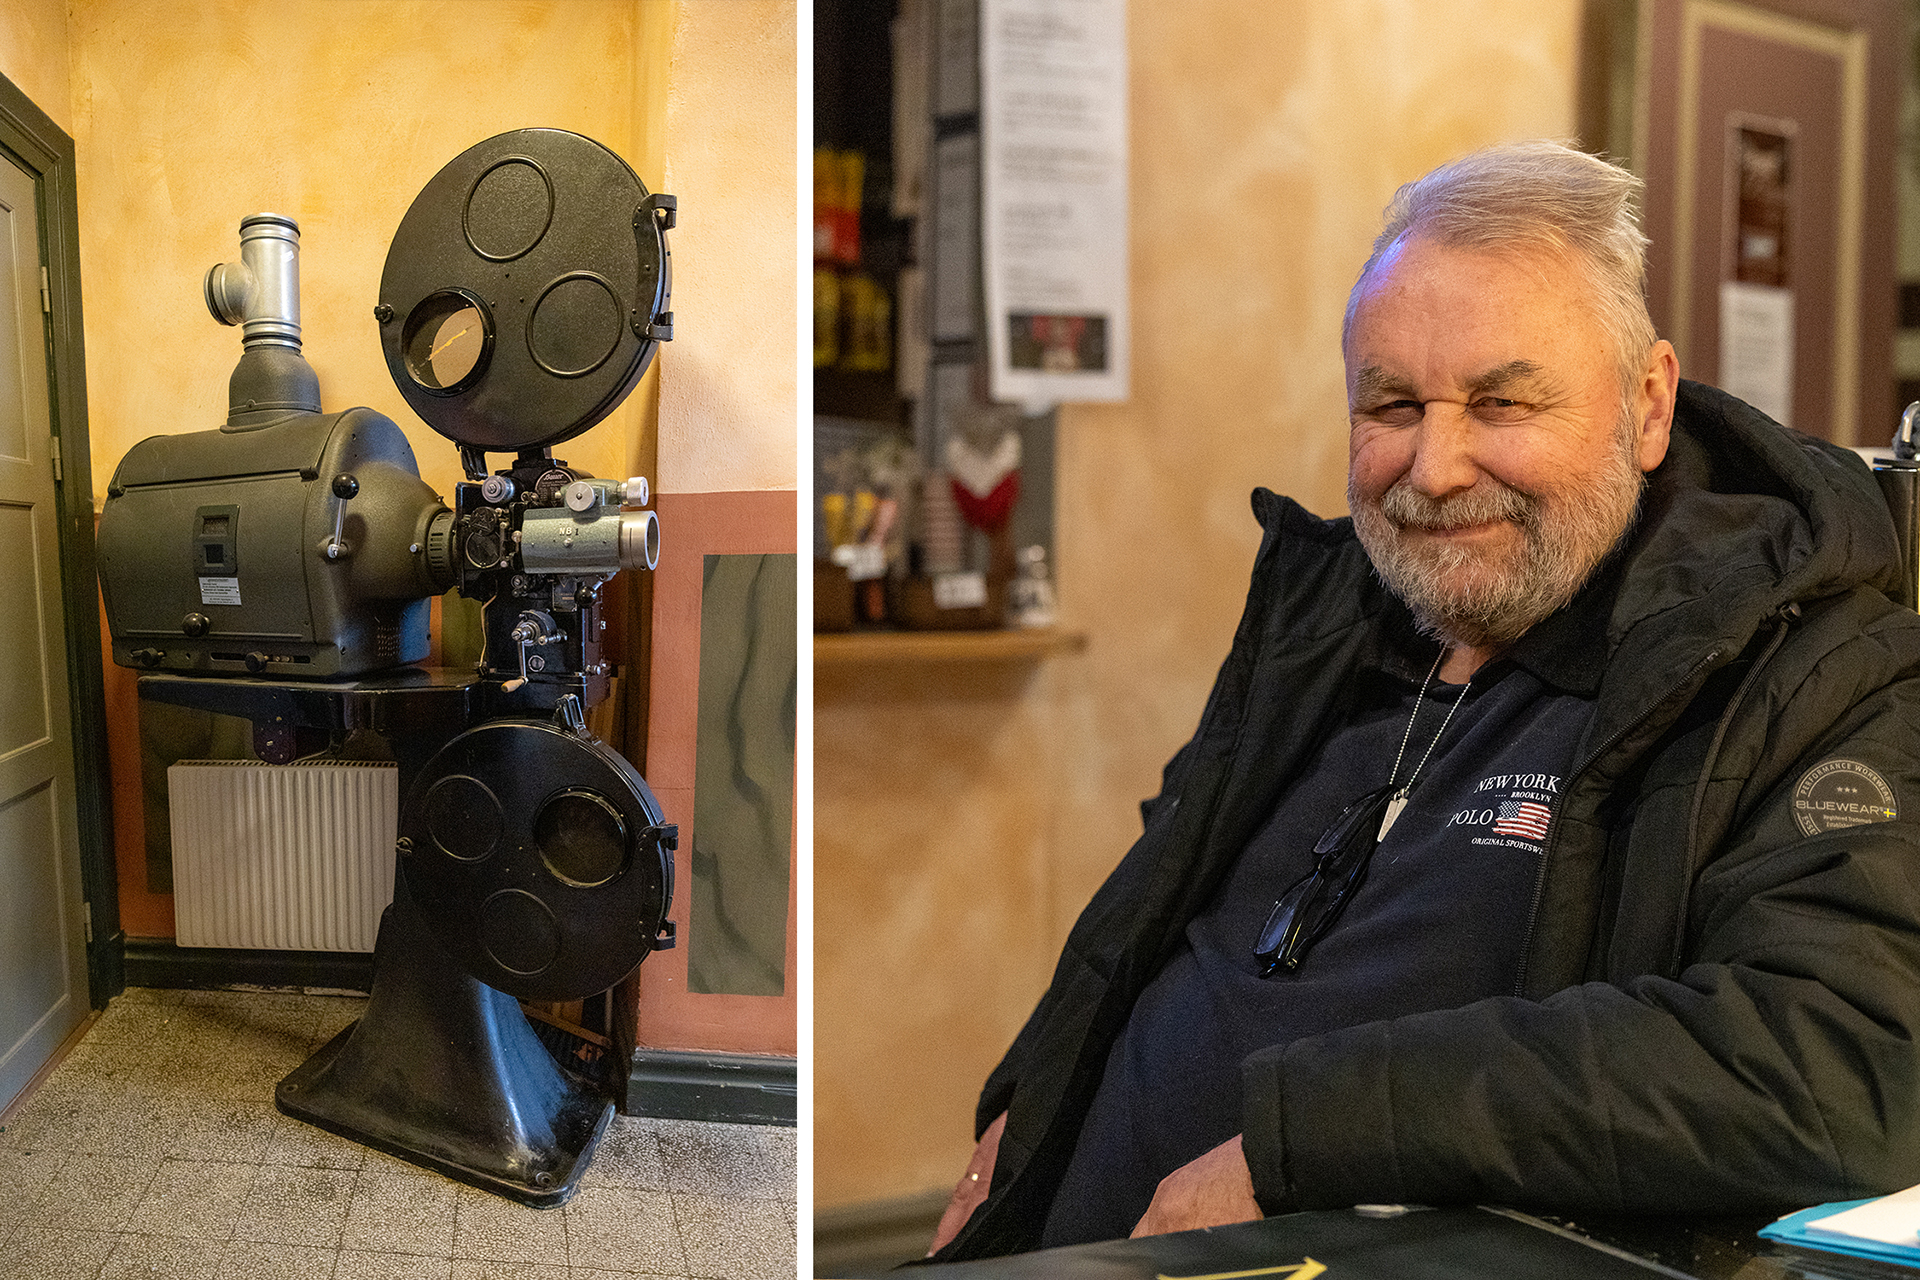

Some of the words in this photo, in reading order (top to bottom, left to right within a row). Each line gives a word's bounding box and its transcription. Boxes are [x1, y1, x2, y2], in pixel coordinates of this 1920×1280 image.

[1473, 774, 1513, 793] NEW
[1512, 773, 1561, 793] YORK
[1800, 762, 1851, 796] PERFORMANCE
[1855, 764, 1892, 802] WORKWEAR
[1511, 791, 1552, 802] BROOKLYN
[1446, 808, 1494, 828] POLO
[1801, 815, 1819, 836] ESSE
[1471, 837, 1504, 846] ORIGINAL
